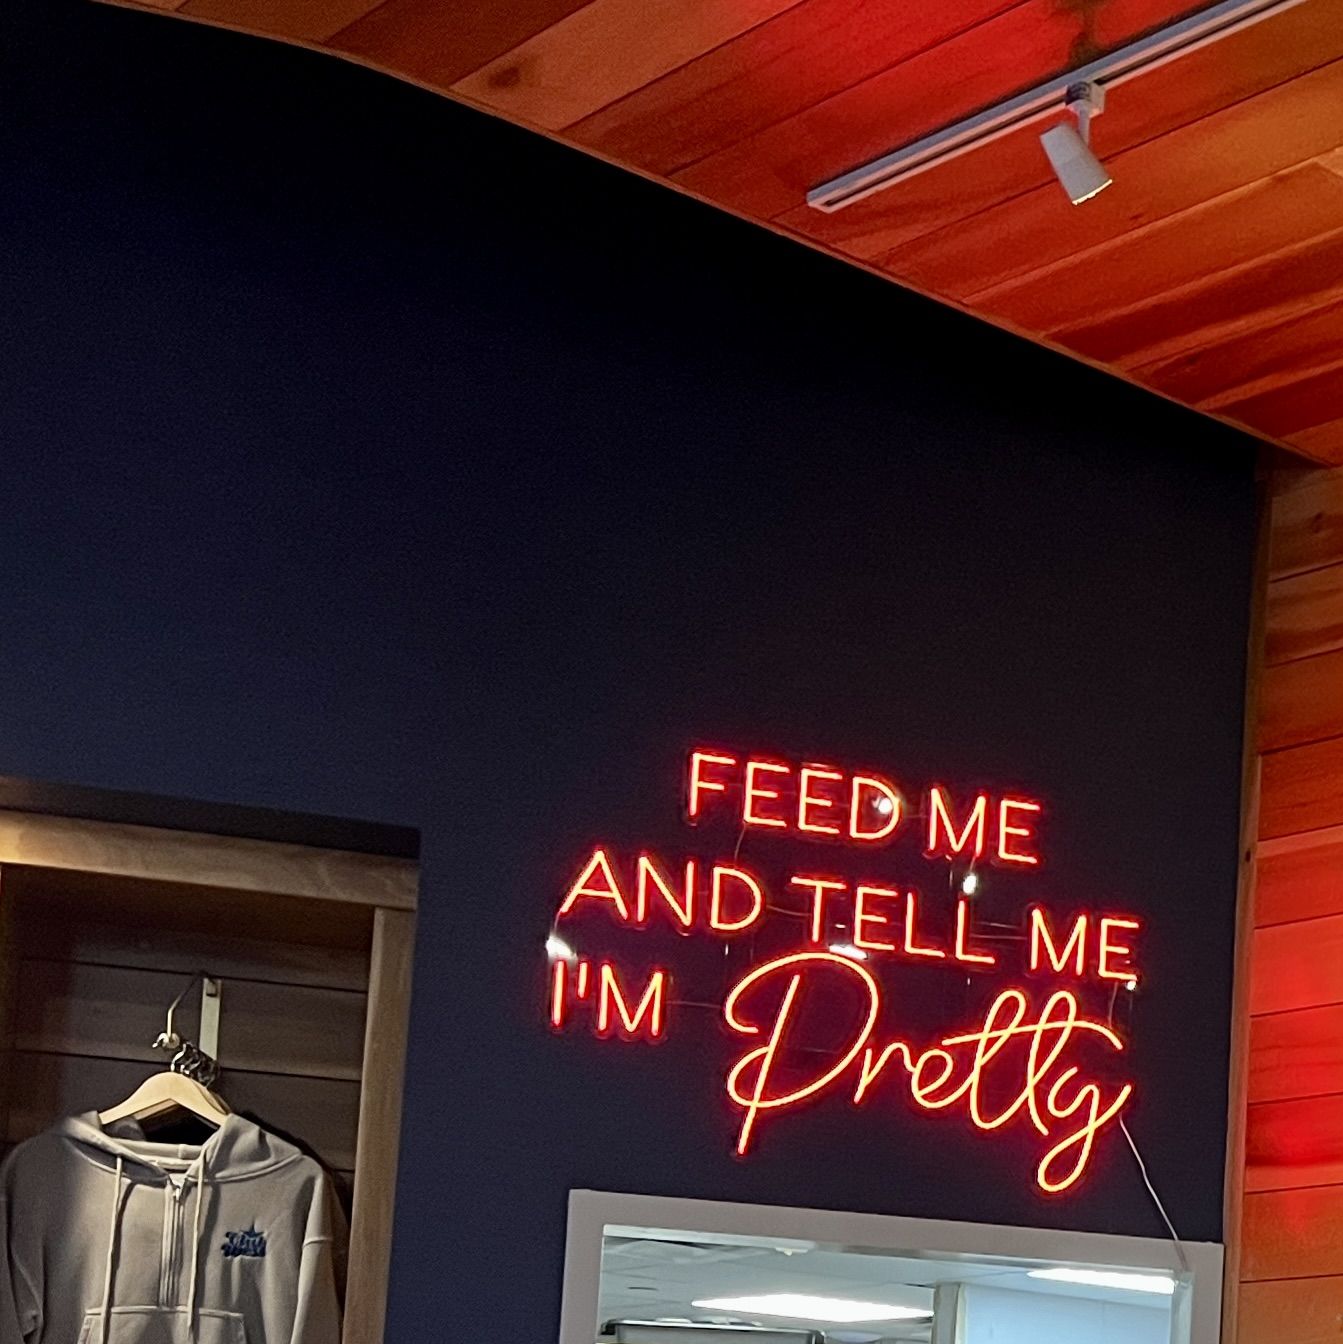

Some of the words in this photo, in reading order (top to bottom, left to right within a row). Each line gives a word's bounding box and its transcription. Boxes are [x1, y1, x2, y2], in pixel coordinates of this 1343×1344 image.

[688, 751, 900, 841] FEED
[927, 786, 1042, 865] ME
[558, 849, 765, 932] AND
[790, 875, 997, 965] TELL
[1029, 907, 1140, 983] ME
[549, 960, 667, 1037] I'M
[723, 950, 1132, 1193] Pretty
